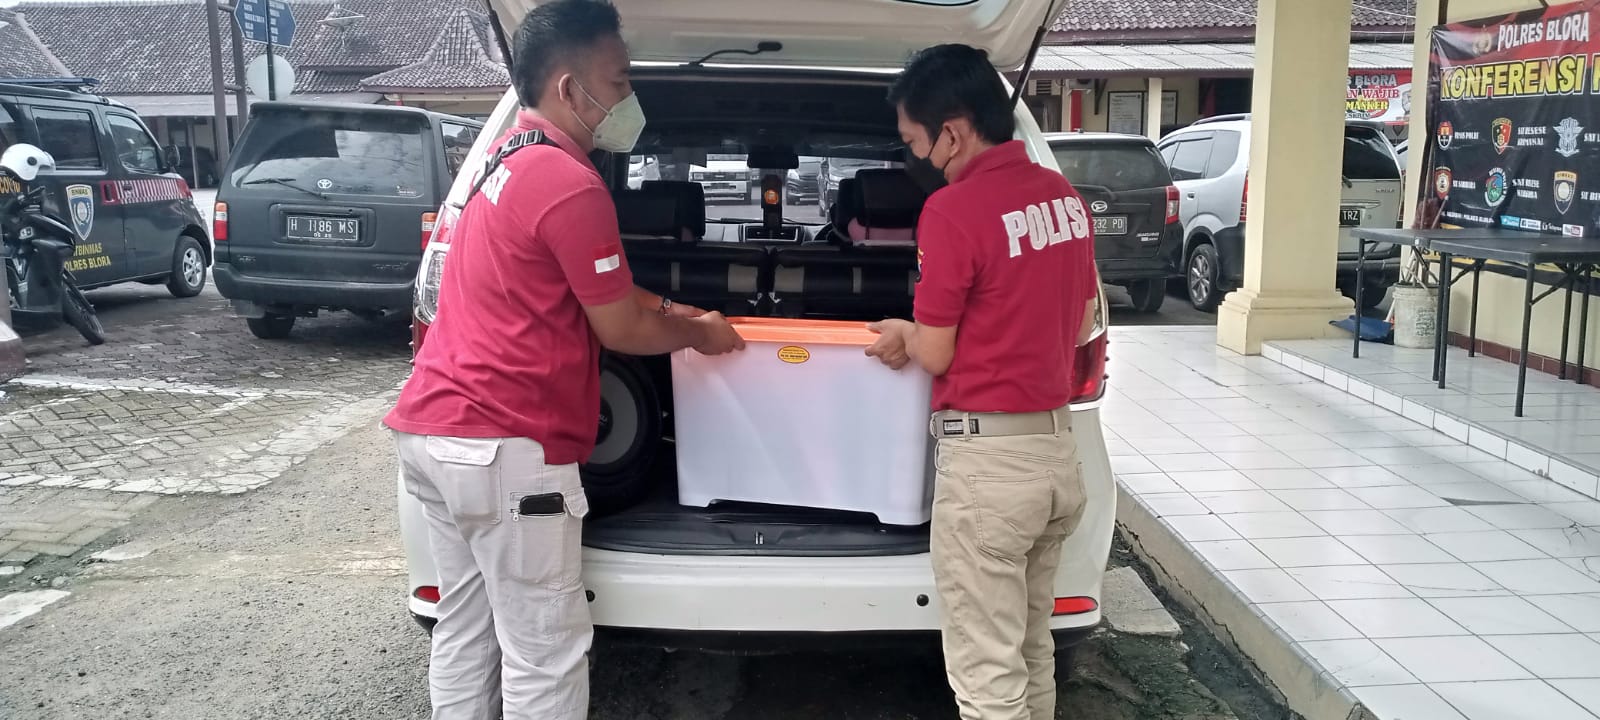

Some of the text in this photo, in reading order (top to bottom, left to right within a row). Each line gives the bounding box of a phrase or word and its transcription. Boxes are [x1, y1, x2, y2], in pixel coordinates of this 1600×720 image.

[1497, 12, 1590, 51] POLRES BLORA
[1355, 74, 1397, 86] BLORA
[1440, 54, 1587, 100] KONFERENSI
[1362, 88, 1400, 98] WAJIB
[1345, 101, 1388, 110] MASKER
[1343, 210, 1359, 221] TRZ
[291, 219, 354, 233] H 1186 MS
[1112, 218, 1123, 229] PD
[73, 243, 102, 256] TBINMAS
[64, 256, 111, 272] OLRES BLORA
